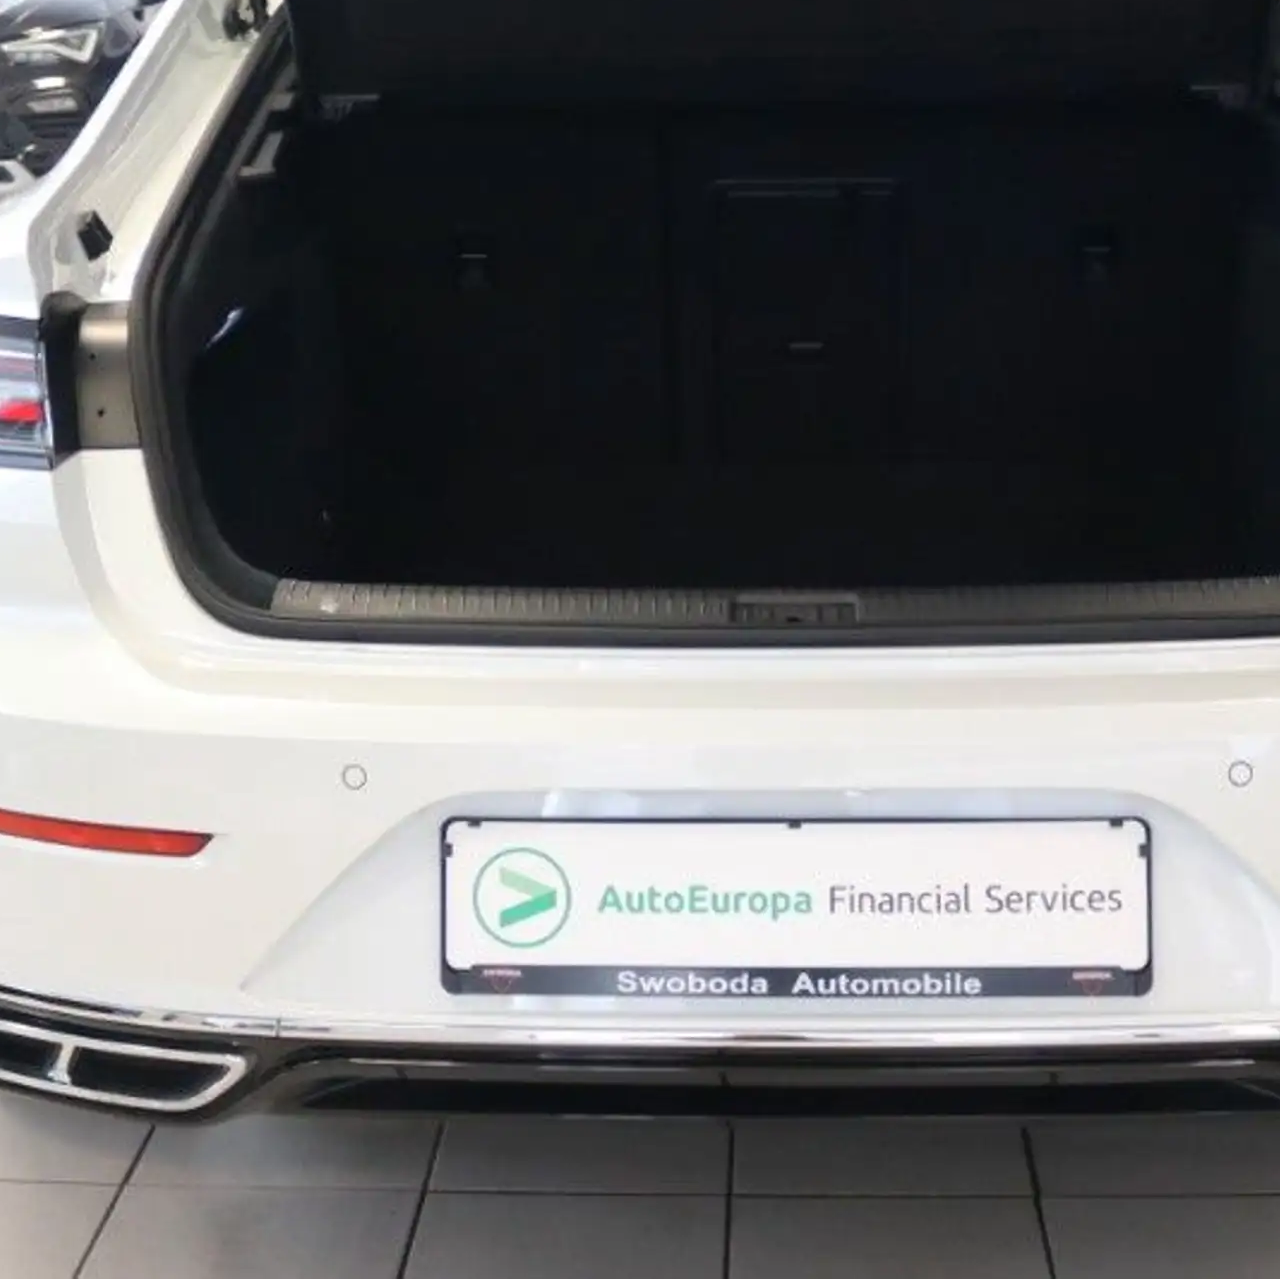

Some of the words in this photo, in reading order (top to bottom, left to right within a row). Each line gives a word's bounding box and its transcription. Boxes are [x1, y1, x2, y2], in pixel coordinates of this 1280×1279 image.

[598, 884, 813, 922] AutoEuropa
[828, 883, 972, 914] Financial
[984, 883, 1123, 913] Services
[617, 970, 769, 995] Swoboda
[791, 971, 983, 996] Automobile
